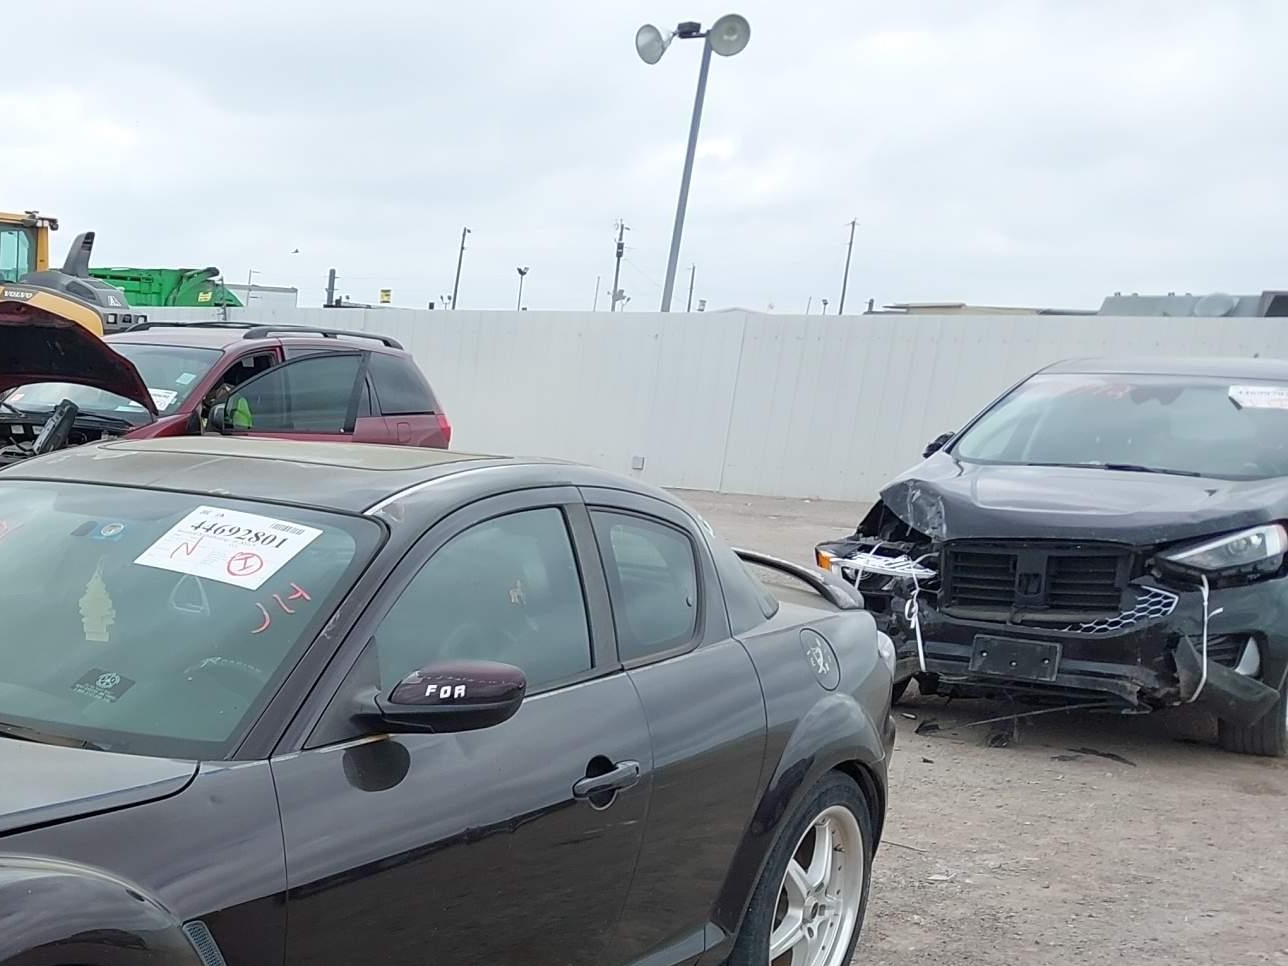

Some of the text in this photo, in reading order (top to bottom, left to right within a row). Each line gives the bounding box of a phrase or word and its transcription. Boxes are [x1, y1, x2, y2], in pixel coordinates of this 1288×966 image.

[4, 290, 33, 299] VOLVO
[190, 519, 289, 549] 44692801
[425, 684, 466, 699] FOR
